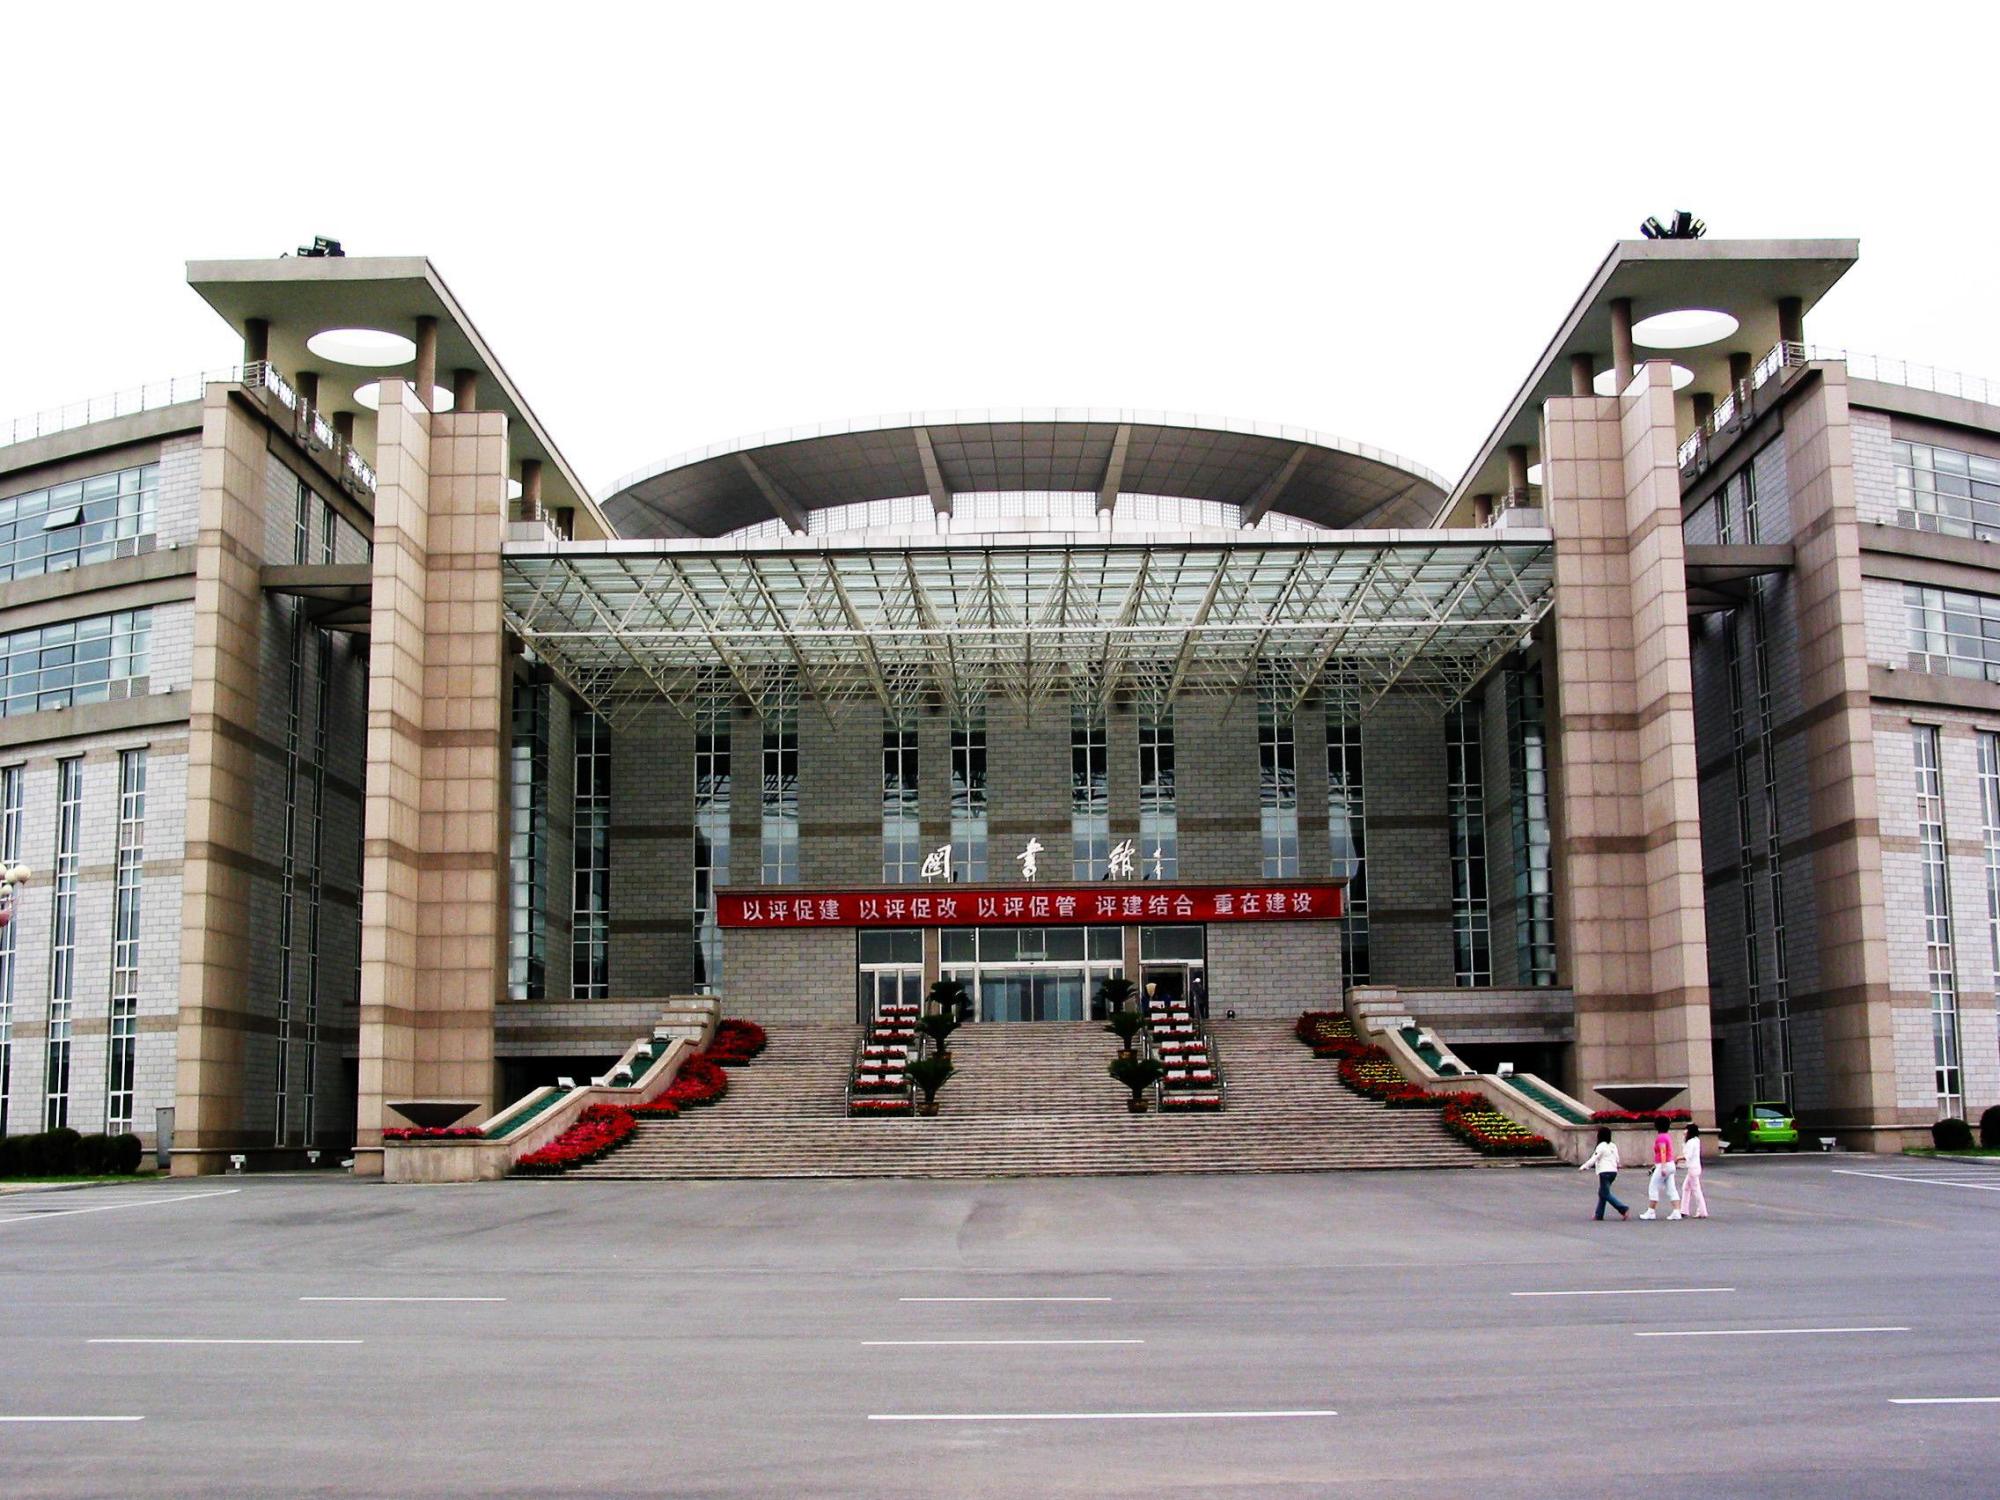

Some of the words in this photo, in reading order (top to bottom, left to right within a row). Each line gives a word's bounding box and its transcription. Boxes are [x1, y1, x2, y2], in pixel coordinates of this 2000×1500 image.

[742, 898, 841, 921] 以评促建
[859, 897, 957, 920] 以评促改
[978, 895, 1077, 918] 以评促管
[1095, 893, 1194, 917] 评建结合
[1213, 892, 1313, 915] 重在建设
